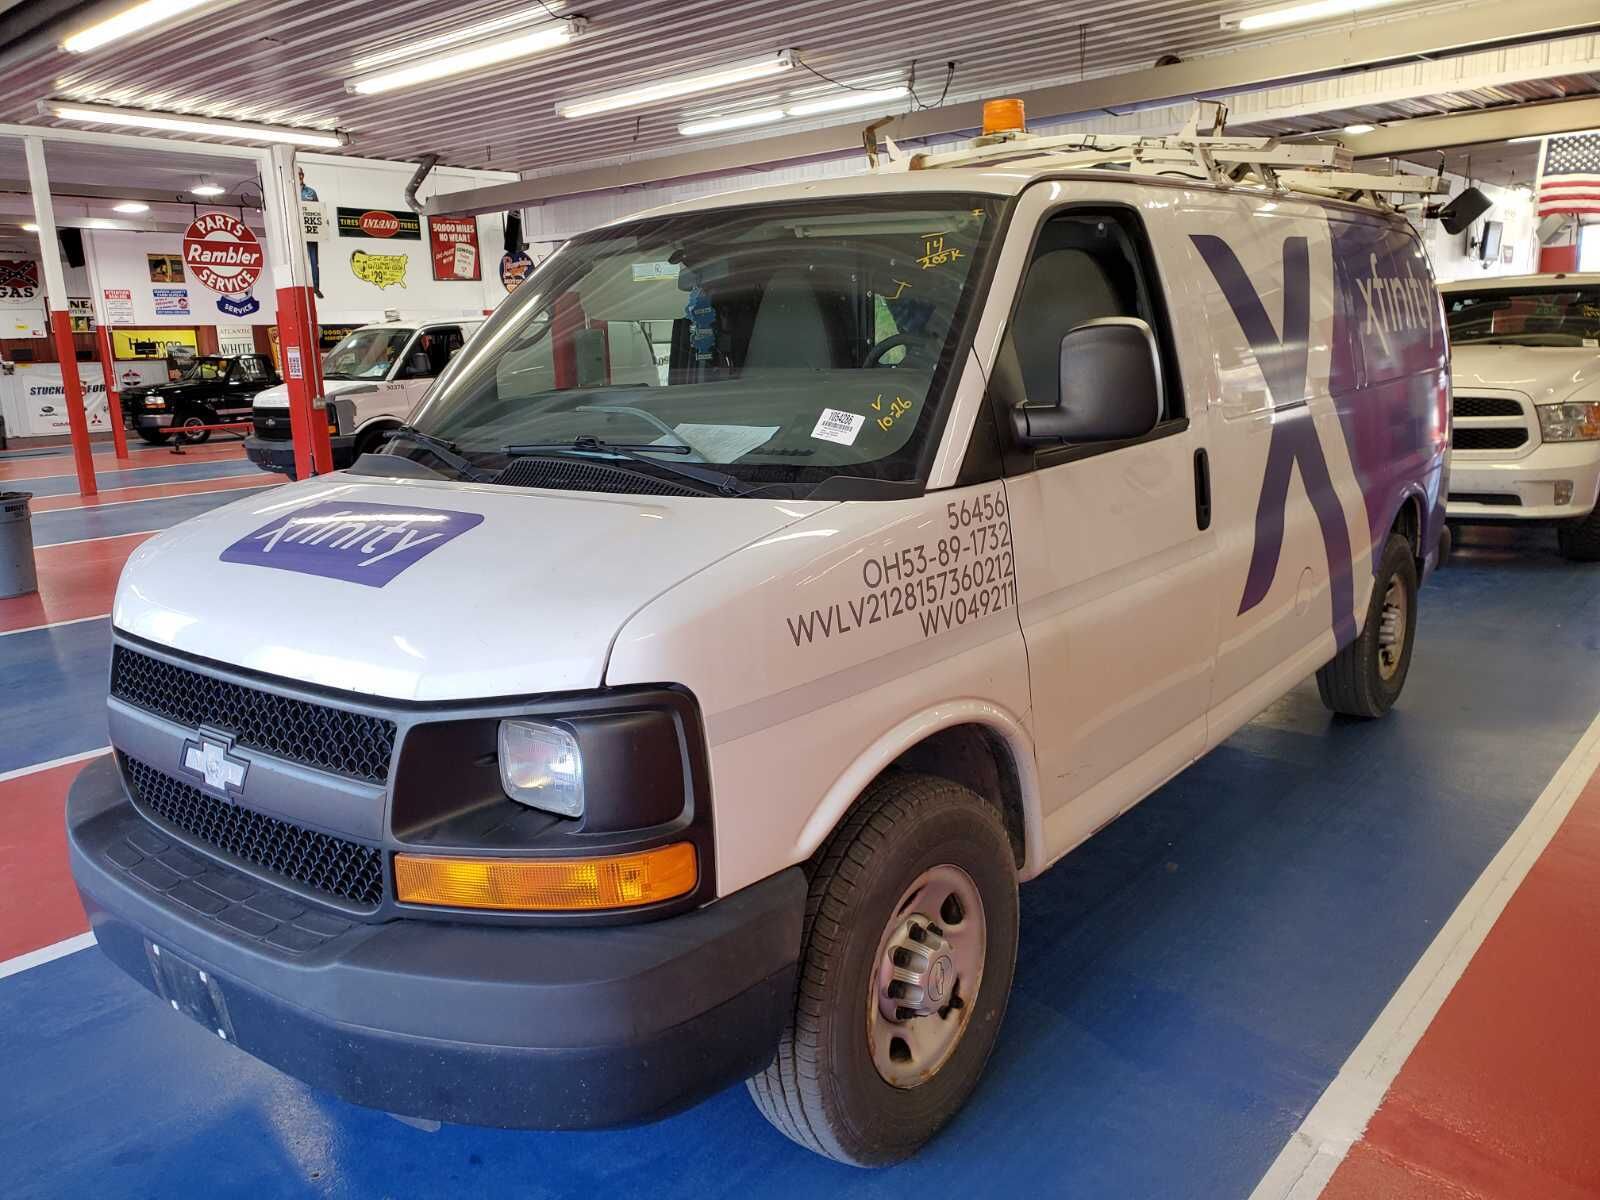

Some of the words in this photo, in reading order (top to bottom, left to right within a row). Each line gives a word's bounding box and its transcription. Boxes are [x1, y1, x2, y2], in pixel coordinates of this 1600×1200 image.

[195, 215, 245, 237] PARTS
[340, 218, 359, 226] TIRES
[363, 219, 398, 230] INLAND
[456, 223, 475, 233] MILES
[439, 233, 449, 241] NO
[188, 244, 259, 264] Rambler
[199, 269, 254, 291] SERVICE
[224, 303, 254, 315] SERVICE
[1356, 252, 1434, 357] xfinity
[221, 343, 252, 354] WHITE
[876, 396, 913, 432] 10-26
[946, 491, 1006, 531] 56456
[862, 520, 1011, 589] OH53-89-1732
[786, 550, 1014, 647] WVLV2128157360212
[918, 580, 1015, 638] WV049211
